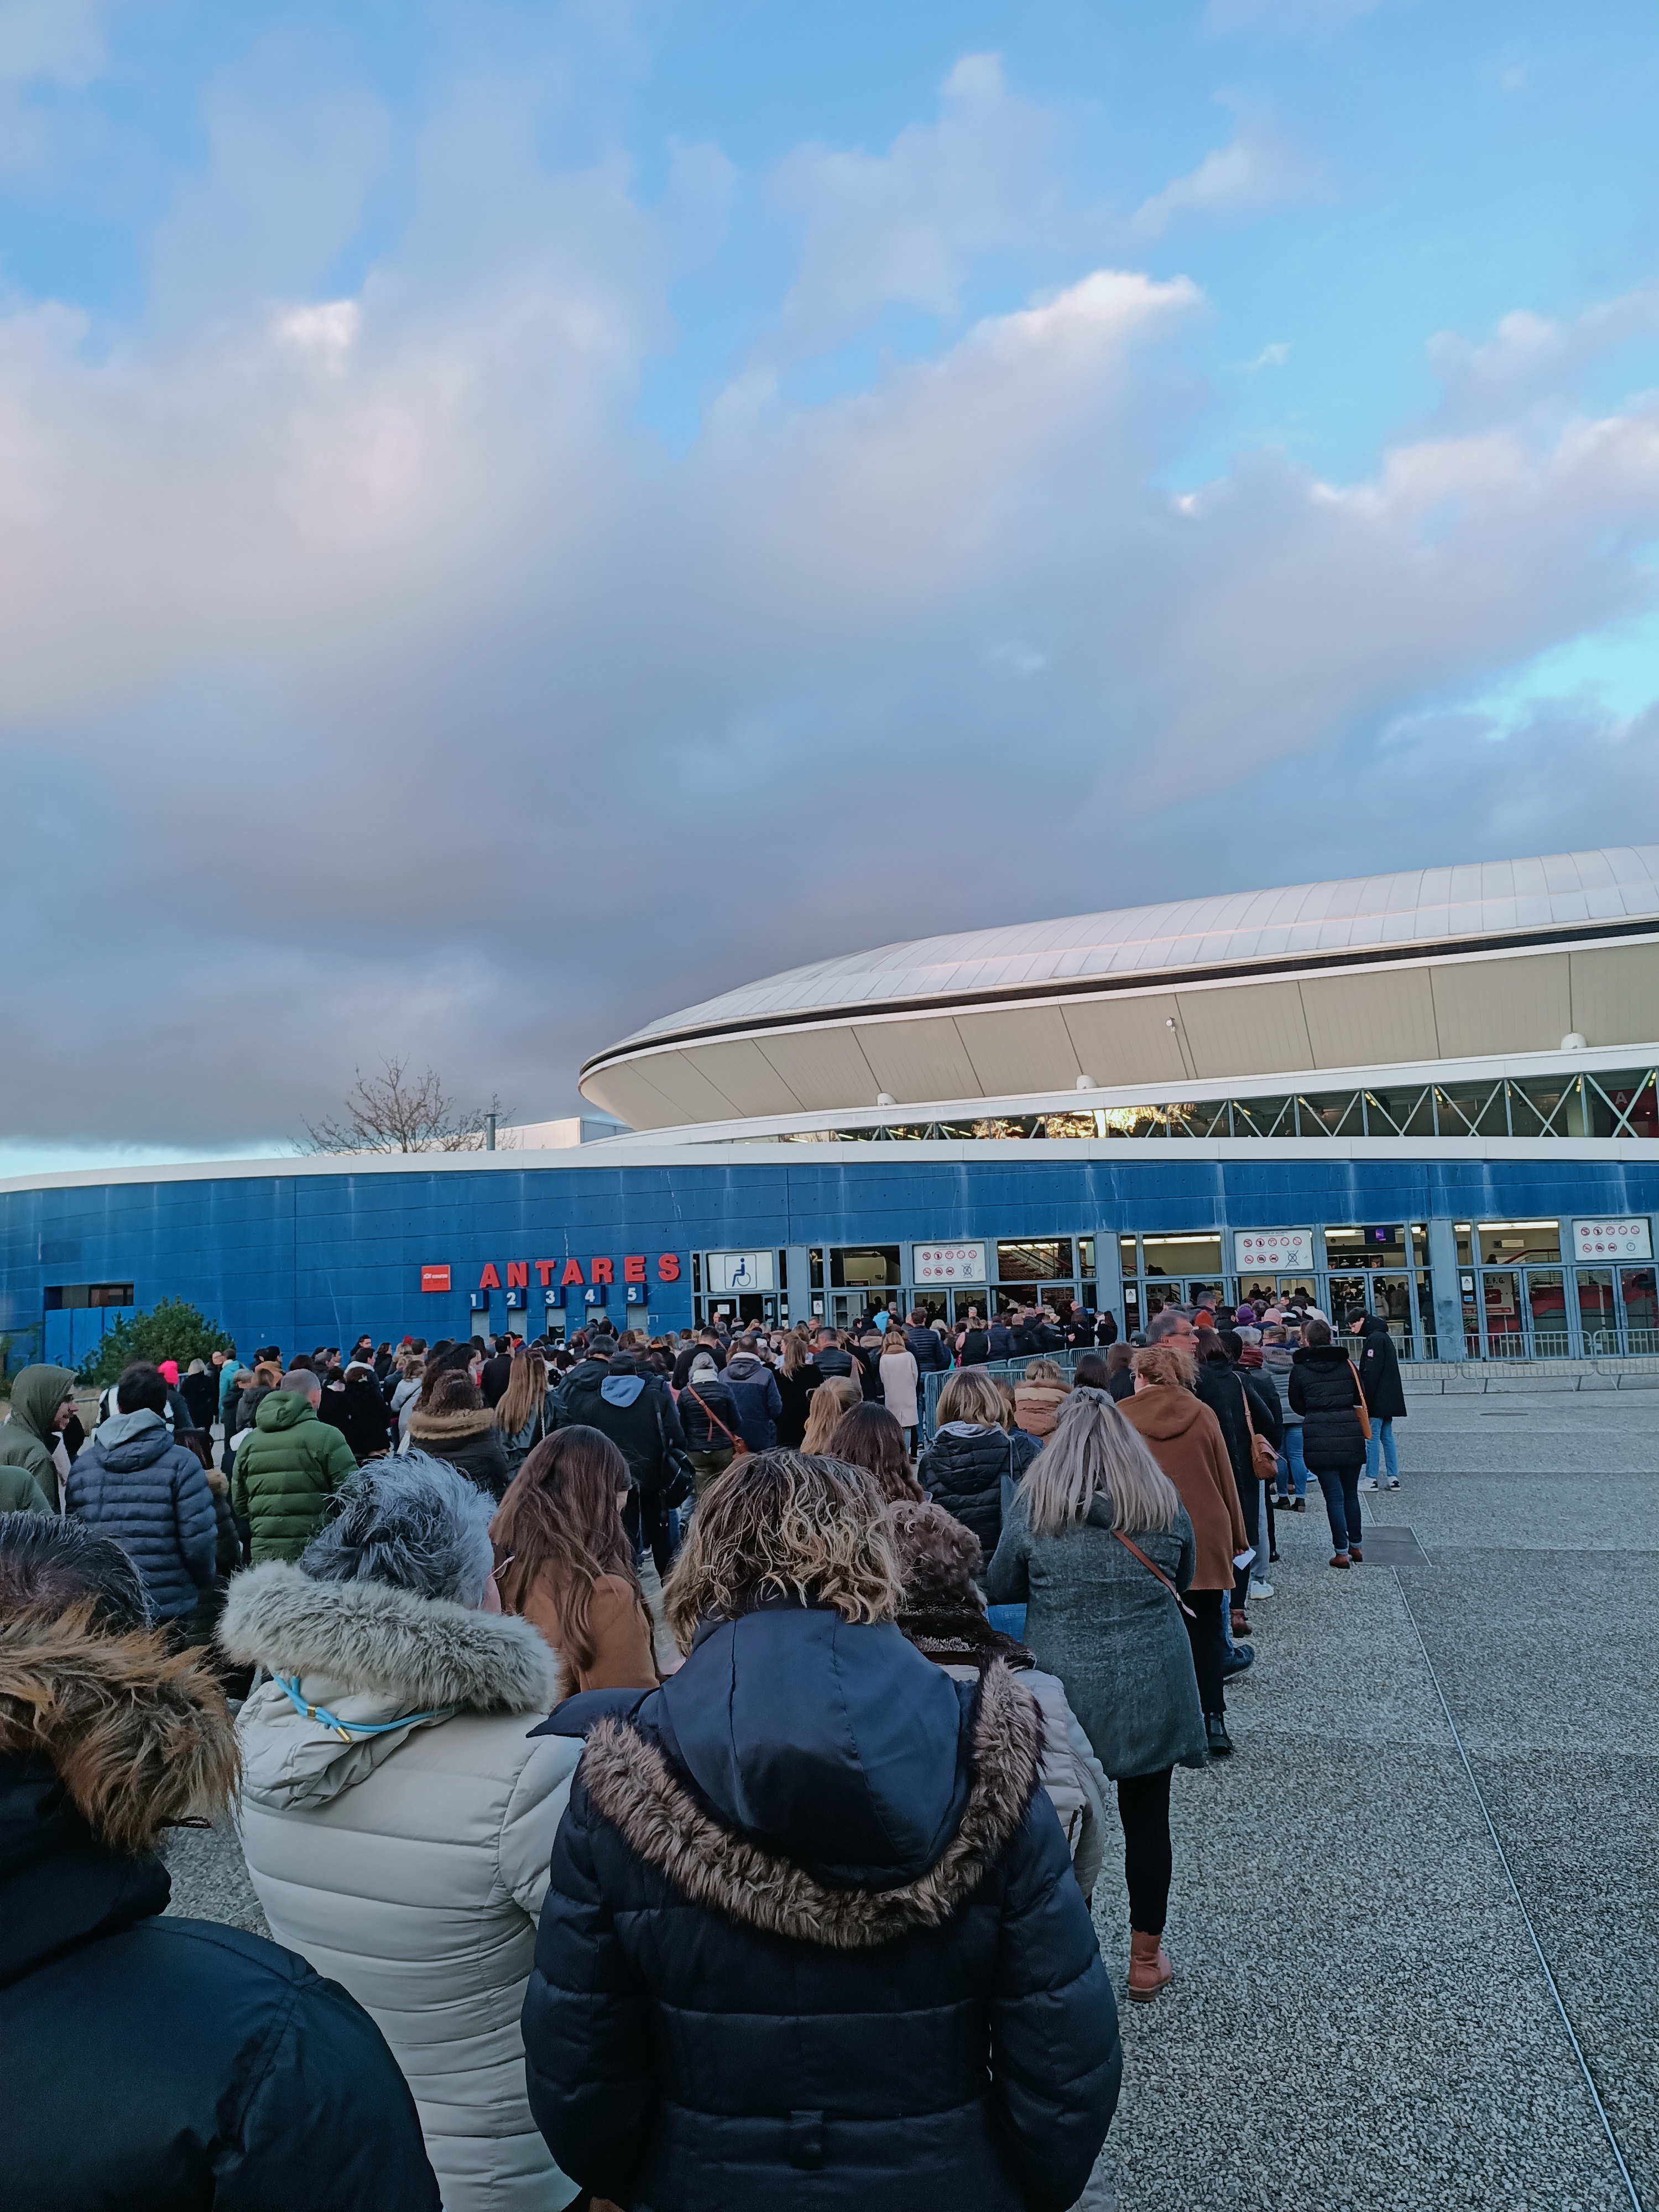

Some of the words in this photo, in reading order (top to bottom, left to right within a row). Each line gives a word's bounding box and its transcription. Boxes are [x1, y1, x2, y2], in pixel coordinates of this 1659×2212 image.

[1615, 1092, 1627, 1104] A
[479, 1254, 680, 1288] ANTARES
[471, 1293, 476, 1307] 1
[507, 1292, 516, 1306] 2
[546, 1290, 555, 1304] 3
[585, 1289, 595, 1302] 4
[628, 1287, 637, 1301] 5
